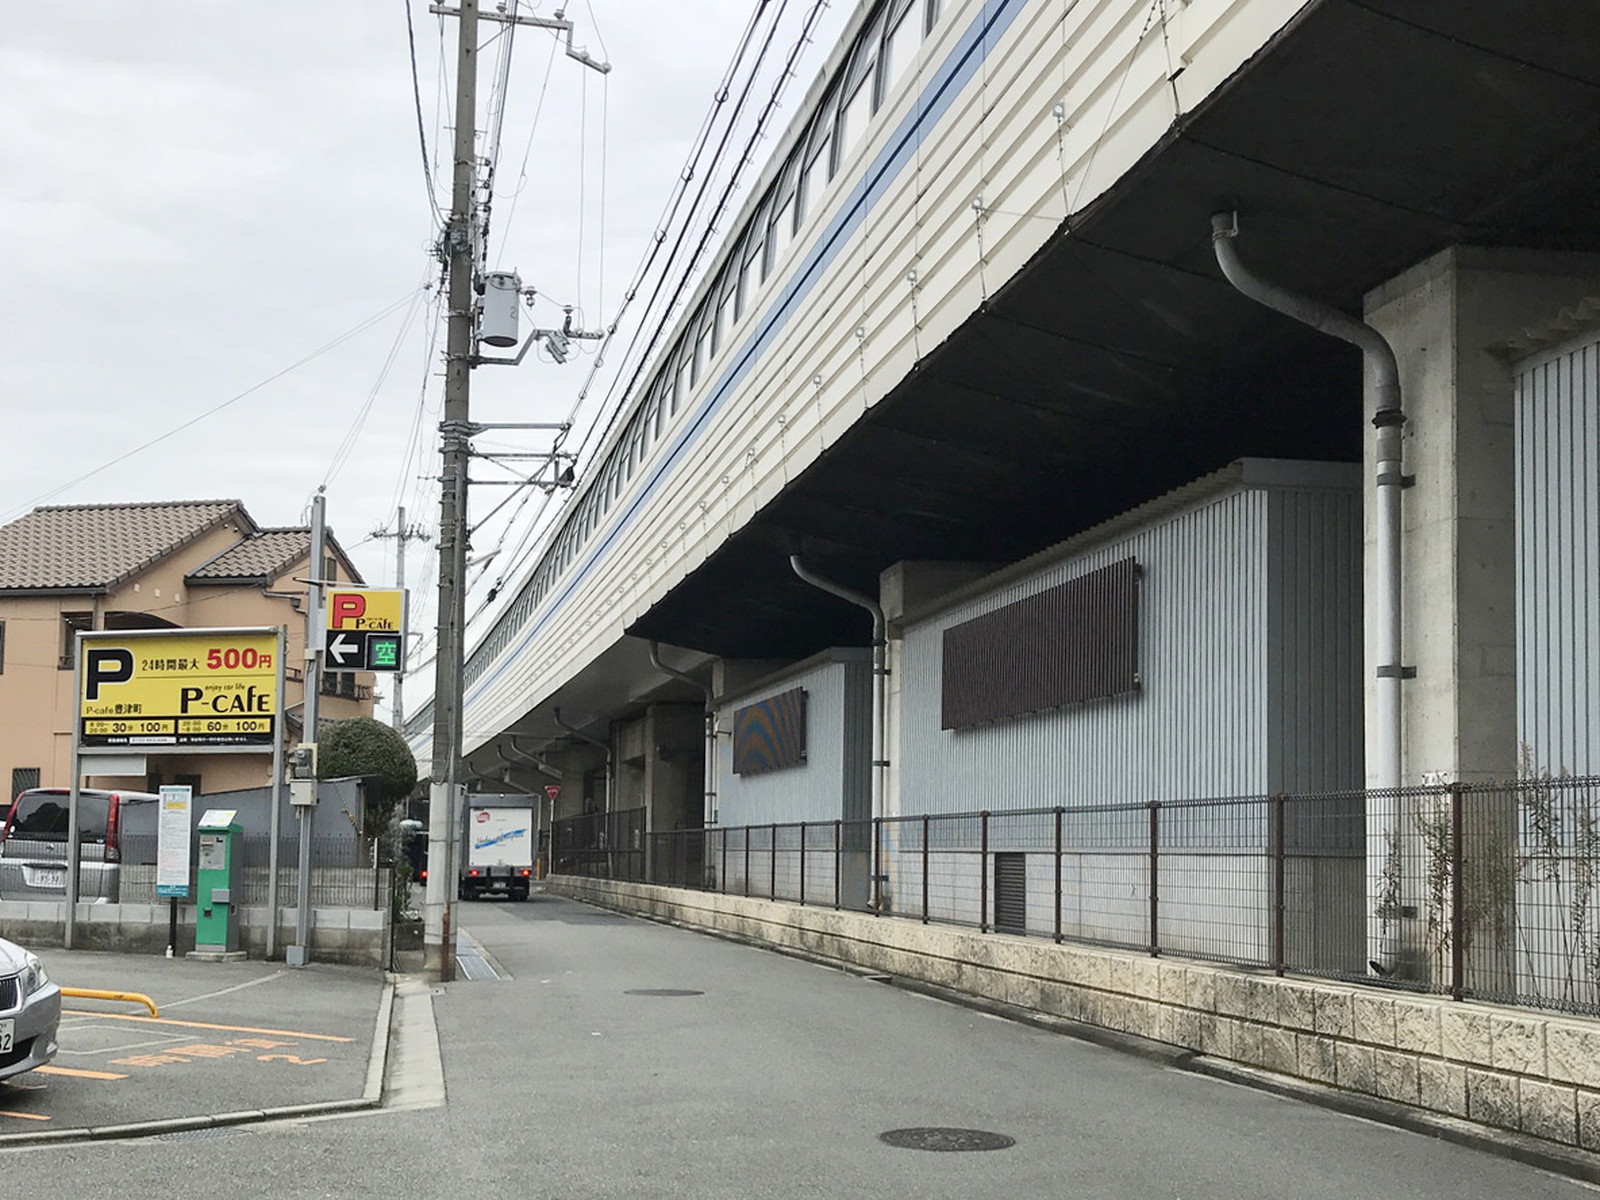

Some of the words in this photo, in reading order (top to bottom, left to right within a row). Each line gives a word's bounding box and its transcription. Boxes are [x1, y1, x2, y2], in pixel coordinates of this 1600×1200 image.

[332, 593, 366, 629] P
[142, 658, 199, 671] 24時間最大
[206, 648, 272, 670] 500円
[375, 641, 397, 666] 空
[86, 648, 134, 700] P
